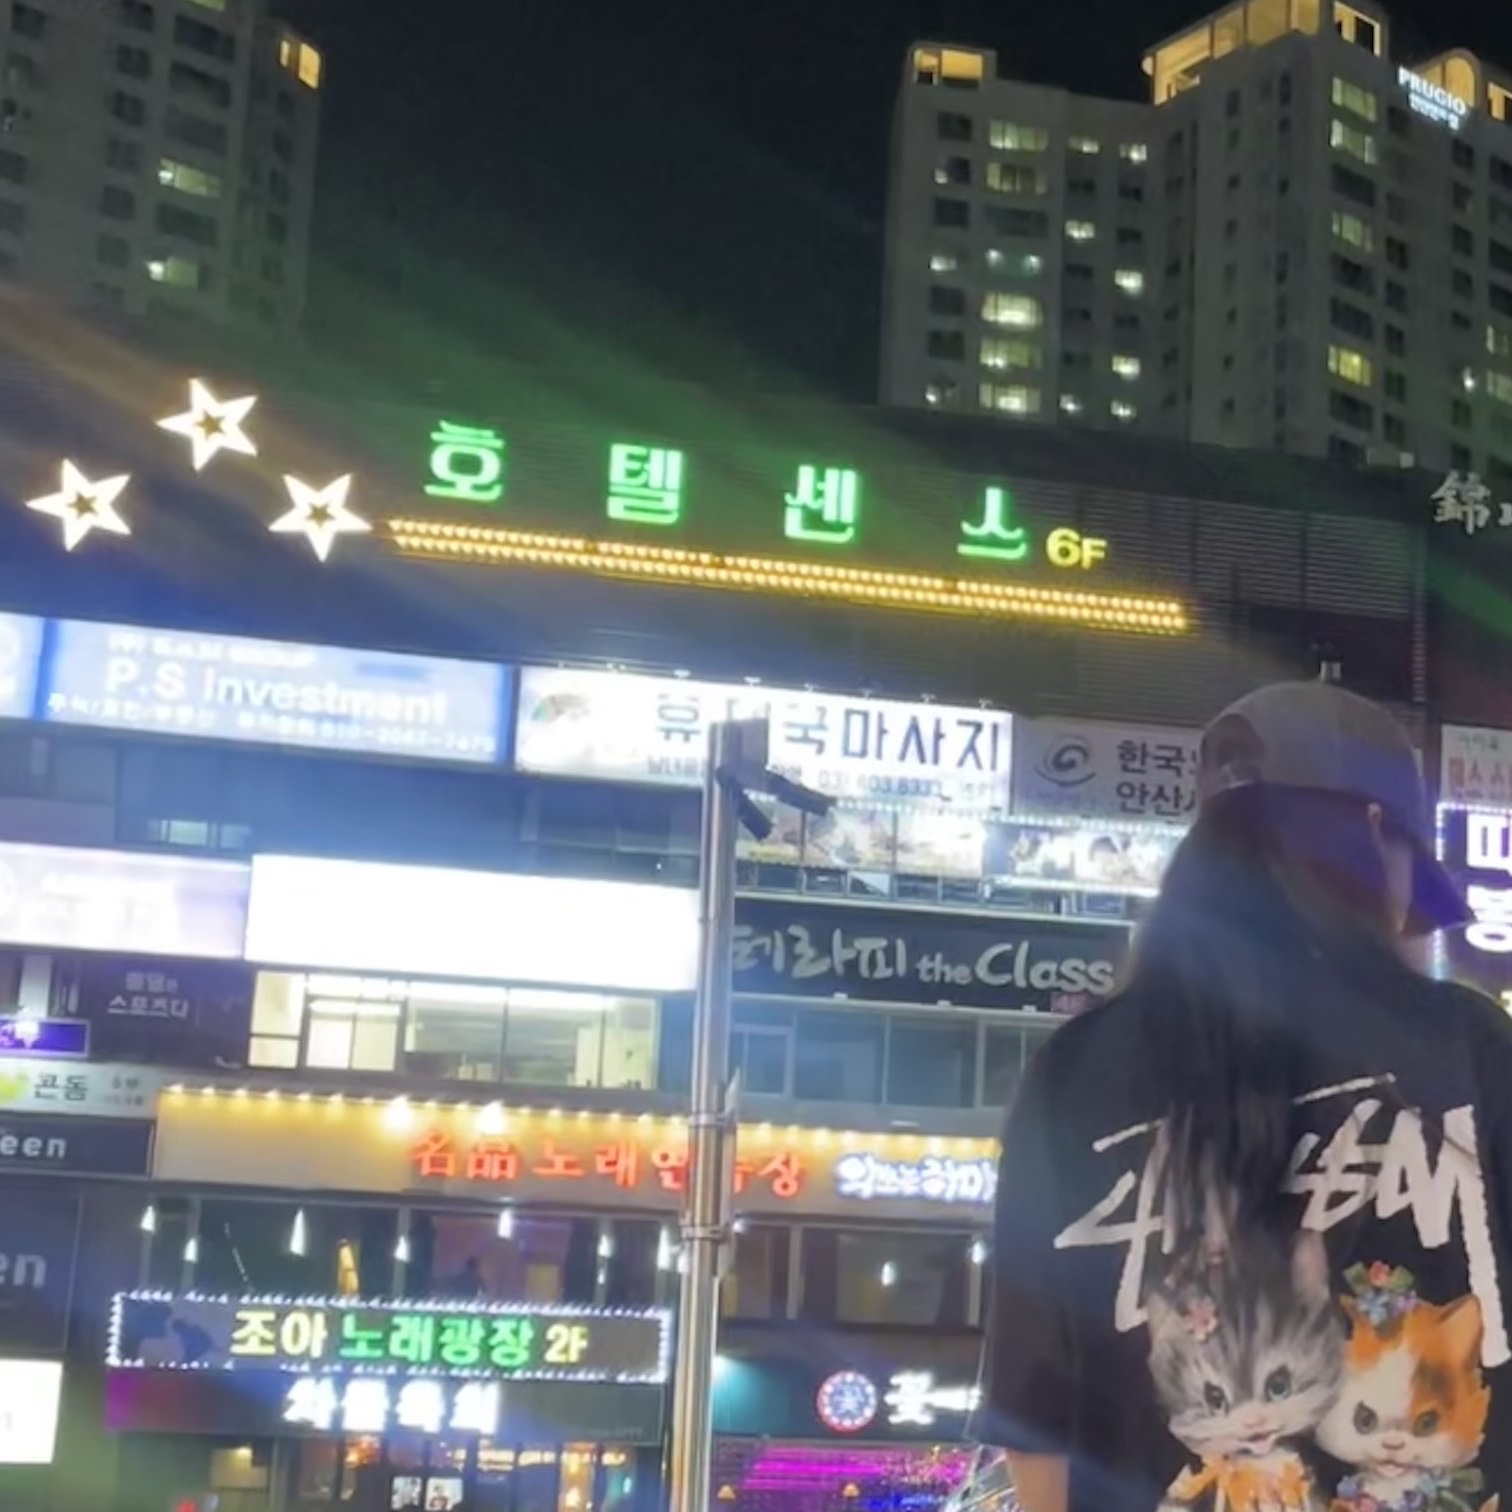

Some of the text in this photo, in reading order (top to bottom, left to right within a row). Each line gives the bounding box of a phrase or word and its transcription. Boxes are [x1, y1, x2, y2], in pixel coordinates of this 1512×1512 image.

[1046, 527, 1108, 569] 6F
[203, 665, 448, 726] Investment
[727, 700, 1000, 772] 국마사지
[1116, 739, 1197, 778] 한국
[1116, 781, 1196, 817] 안산
[916, 952, 974, 986] the
[975, 940, 1116, 996] Class
[230, 1311, 327, 1362] 조아
[339, 1313, 535, 1368] 노래광장
